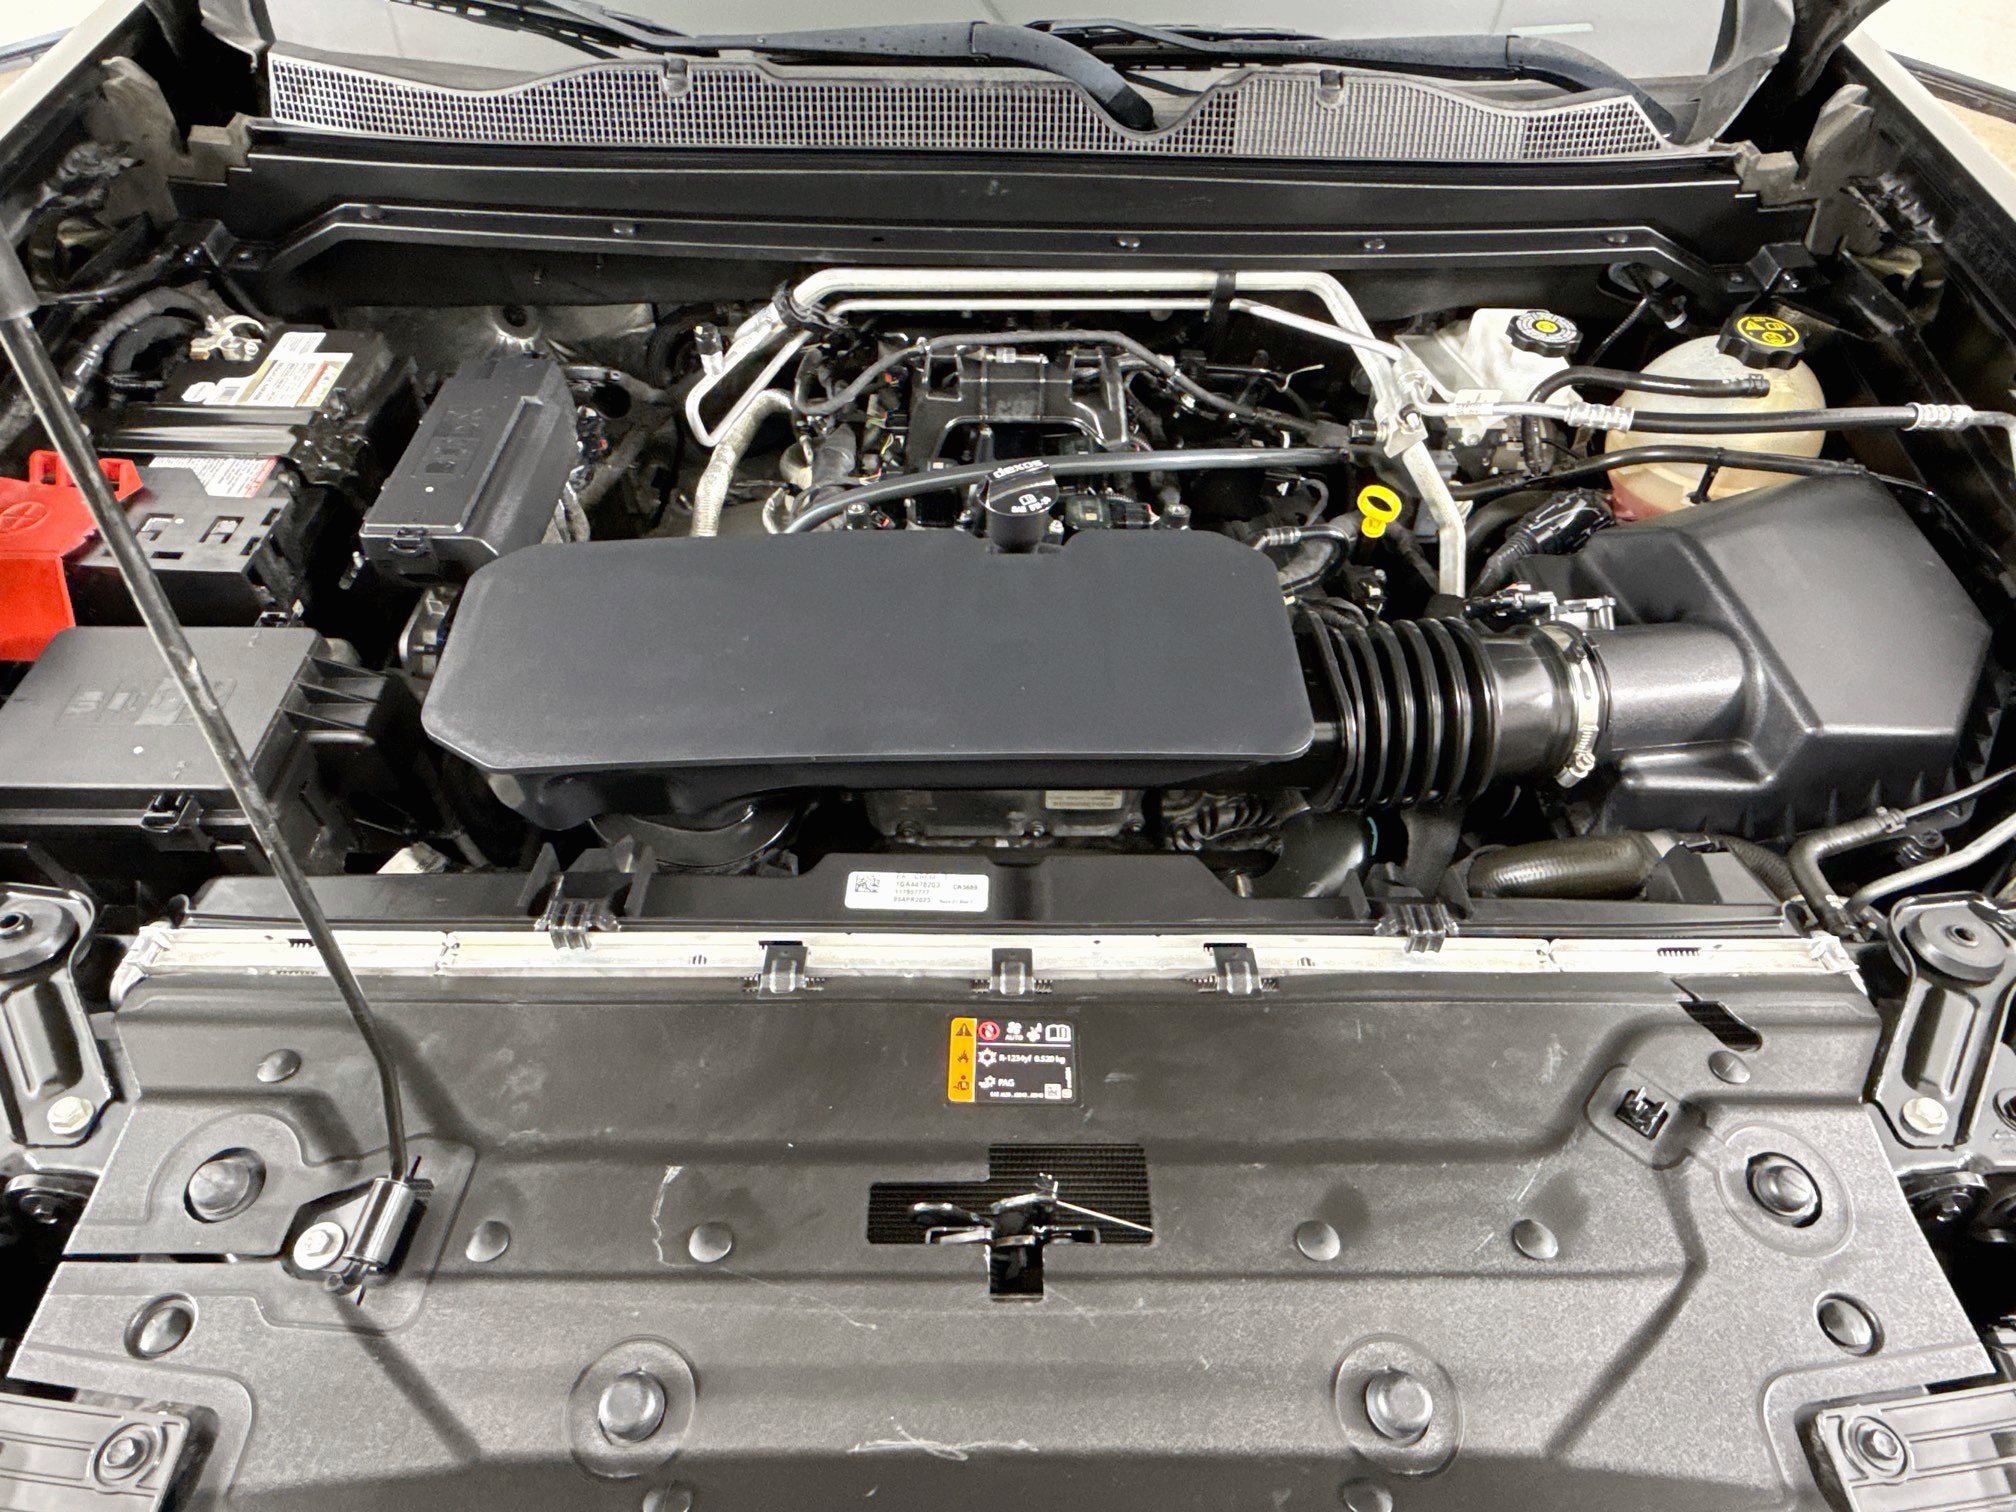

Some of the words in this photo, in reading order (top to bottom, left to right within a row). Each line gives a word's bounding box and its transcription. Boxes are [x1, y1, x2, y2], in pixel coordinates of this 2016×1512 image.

[993, 460, 1044, 478] dexos
[999, 1054, 1031, 1064] R-1234yf
[1055, 1055, 1066, 1065] kg
[998, 1078, 1015, 1087] PAG
